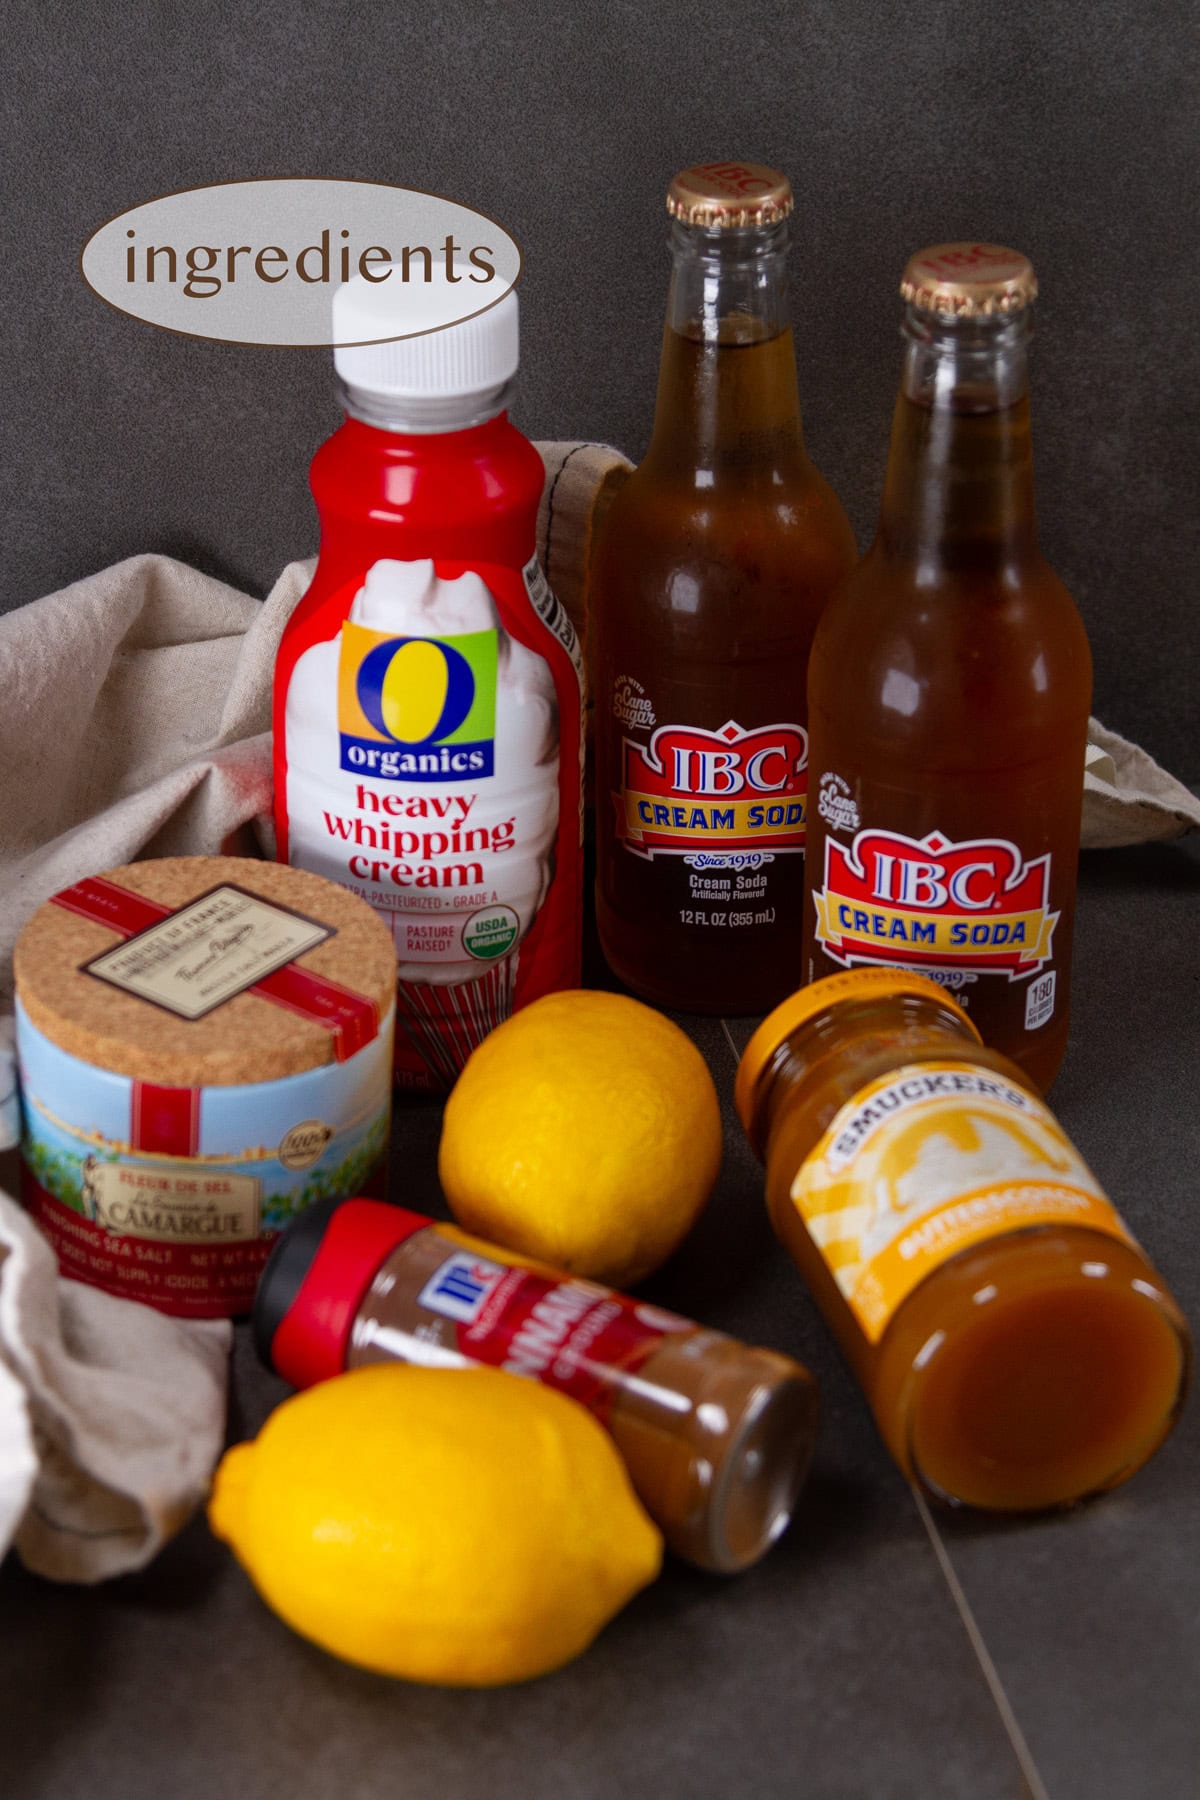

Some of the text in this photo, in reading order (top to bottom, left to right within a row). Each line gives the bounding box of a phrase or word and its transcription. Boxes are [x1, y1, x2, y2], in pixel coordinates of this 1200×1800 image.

[613, 692, 657, 730] Sugar
[623, 685, 653, 712] Cane
[347, 745, 485, 777] organics
[671, 745, 789, 796] IBC
[355, 783, 479, 831] heavy
[818, 789, 861, 830] Sugar
[828, 783, 858, 812] Cane
[637, 799, 735, 830] CREAM
[321, 809, 517, 861] whipping
[347, 854, 486, 889] cream
[694, 852, 762, 870] Since 1919
[689, 873, 768, 890] Cream Soda
[691, 887, 766, 902] Artificially Flavored
[871, 851, 996, 911] IBC
[453, 890, 488, 909] GRADE
[490, 890, 499, 904] A
[406, 924, 456, 939] PASTURE
[475, 915, 509, 934] USDA
[679, 906, 776, 928] 12 FL OZ (355 mL)
[837, 903, 1026, 946] CREAM SODA
[470, 929, 513, 949] ORGANIC
[836, 1073, 1027, 1158] SMUCKER'S
[118, 1169, 232, 1194] FLEUR DE SEL
[108, 1200, 243, 1236] CAMARGUE
[103, 1235, 132, 1258] SEA
[135, 1247, 173, 1266] SALT
